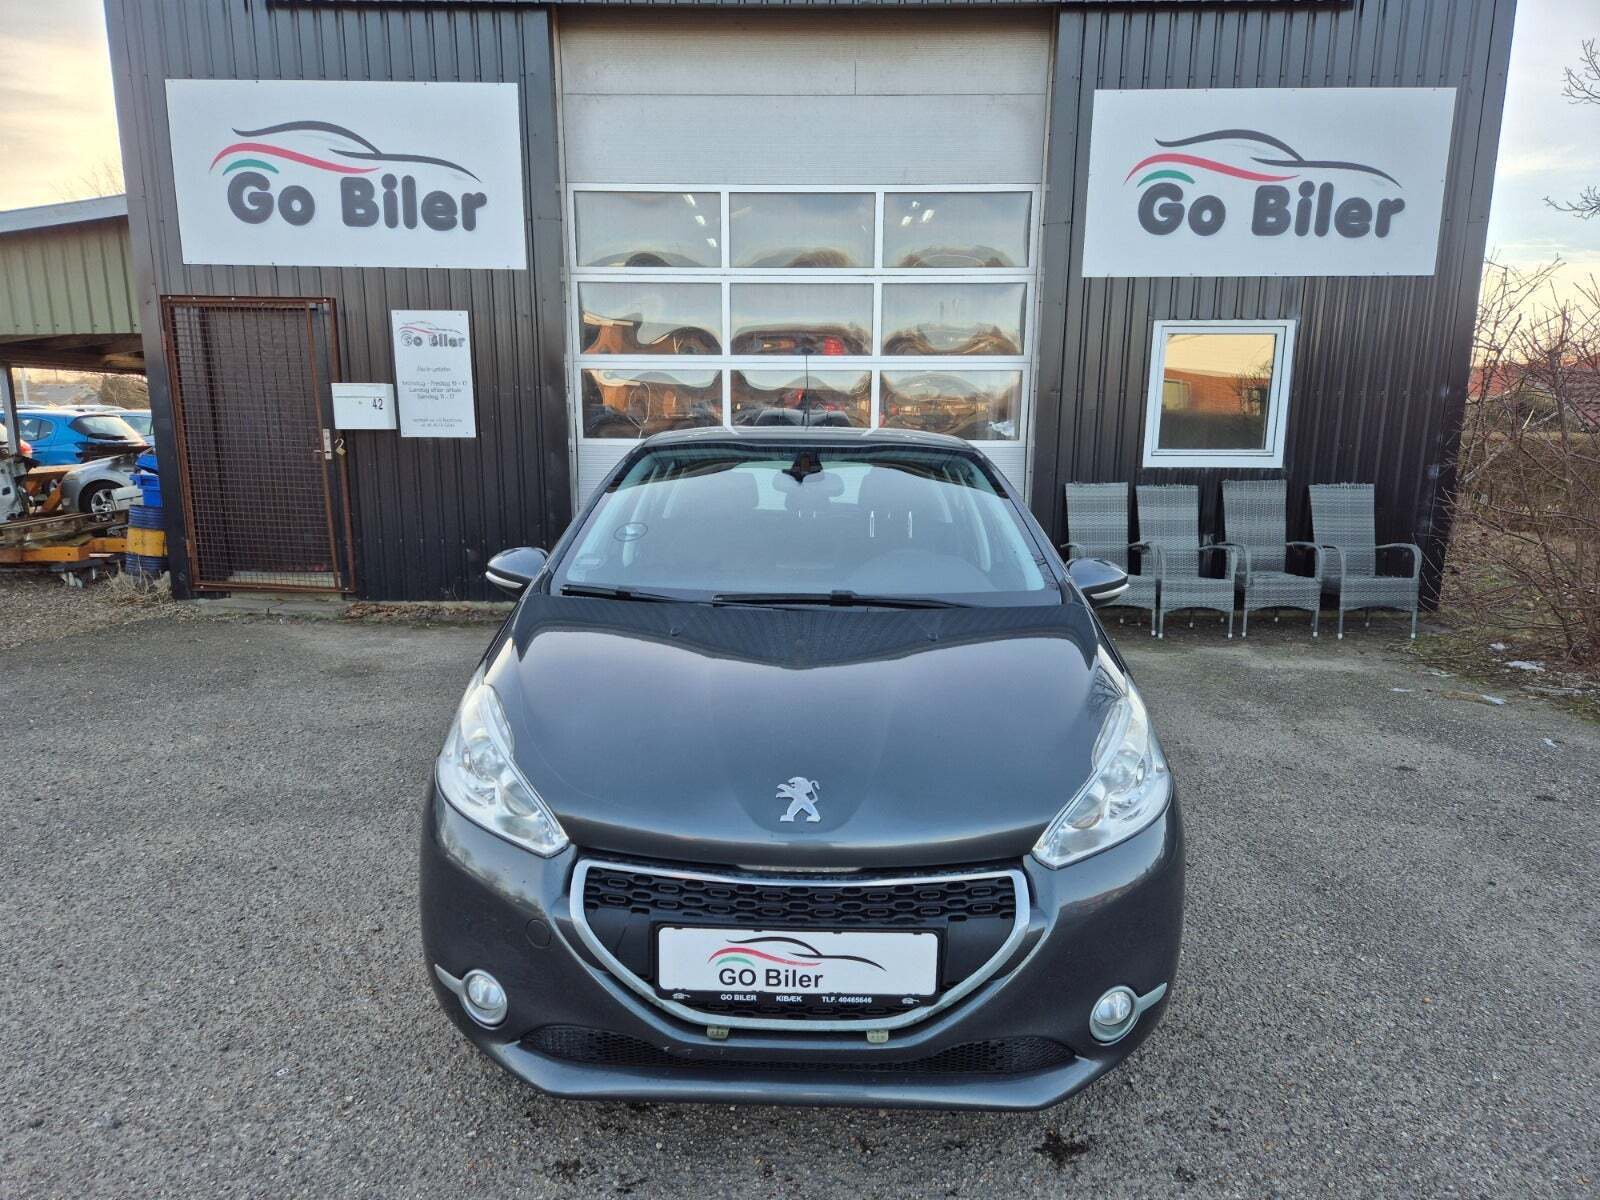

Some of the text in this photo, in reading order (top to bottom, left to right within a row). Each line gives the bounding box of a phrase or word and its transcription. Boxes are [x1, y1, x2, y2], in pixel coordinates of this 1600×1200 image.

[227, 171, 488, 232] Go Biler
[1137, 180, 1406, 239] Go Biler
[372, 398, 383, 410] 42
[718, 968, 824, 988] GO Biler
[720, 993, 733, 1001] GO
[734, 993, 757, 1002] BILER
[775, 994, 803, 1003] KIBÆK
